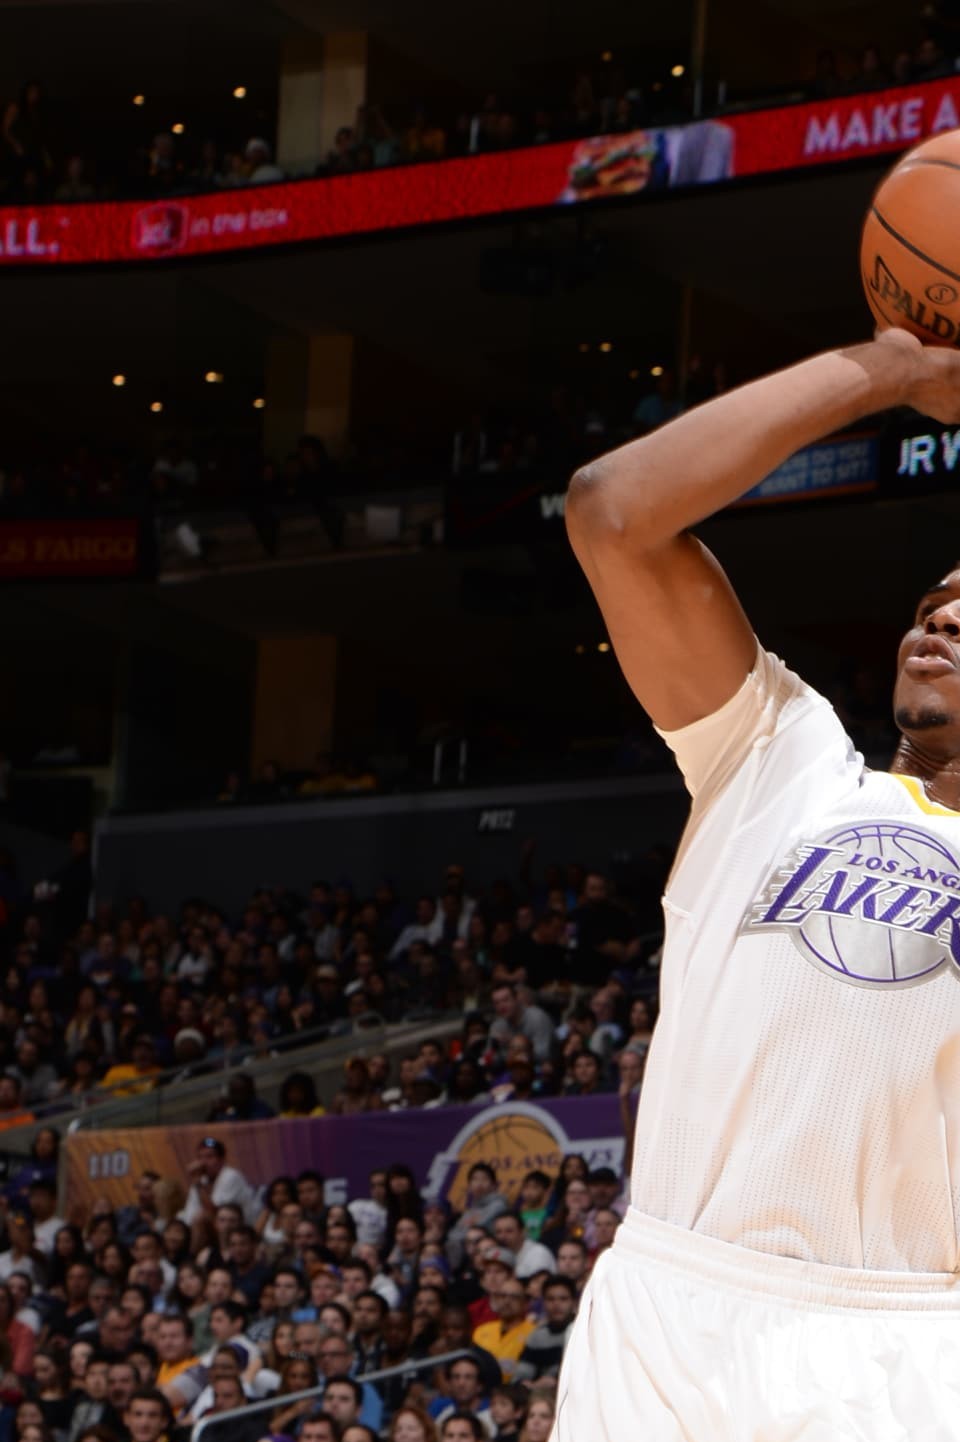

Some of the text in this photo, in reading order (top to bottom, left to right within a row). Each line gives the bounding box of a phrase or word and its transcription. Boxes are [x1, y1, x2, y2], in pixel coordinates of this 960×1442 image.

[804, 98, 925, 156] MAKE
[933, 93, 959, 132] A
[0, 217, 60, 256] LL.
[846, 852, 900, 874] LOS
[88, 1150, 131, 1179] 110
